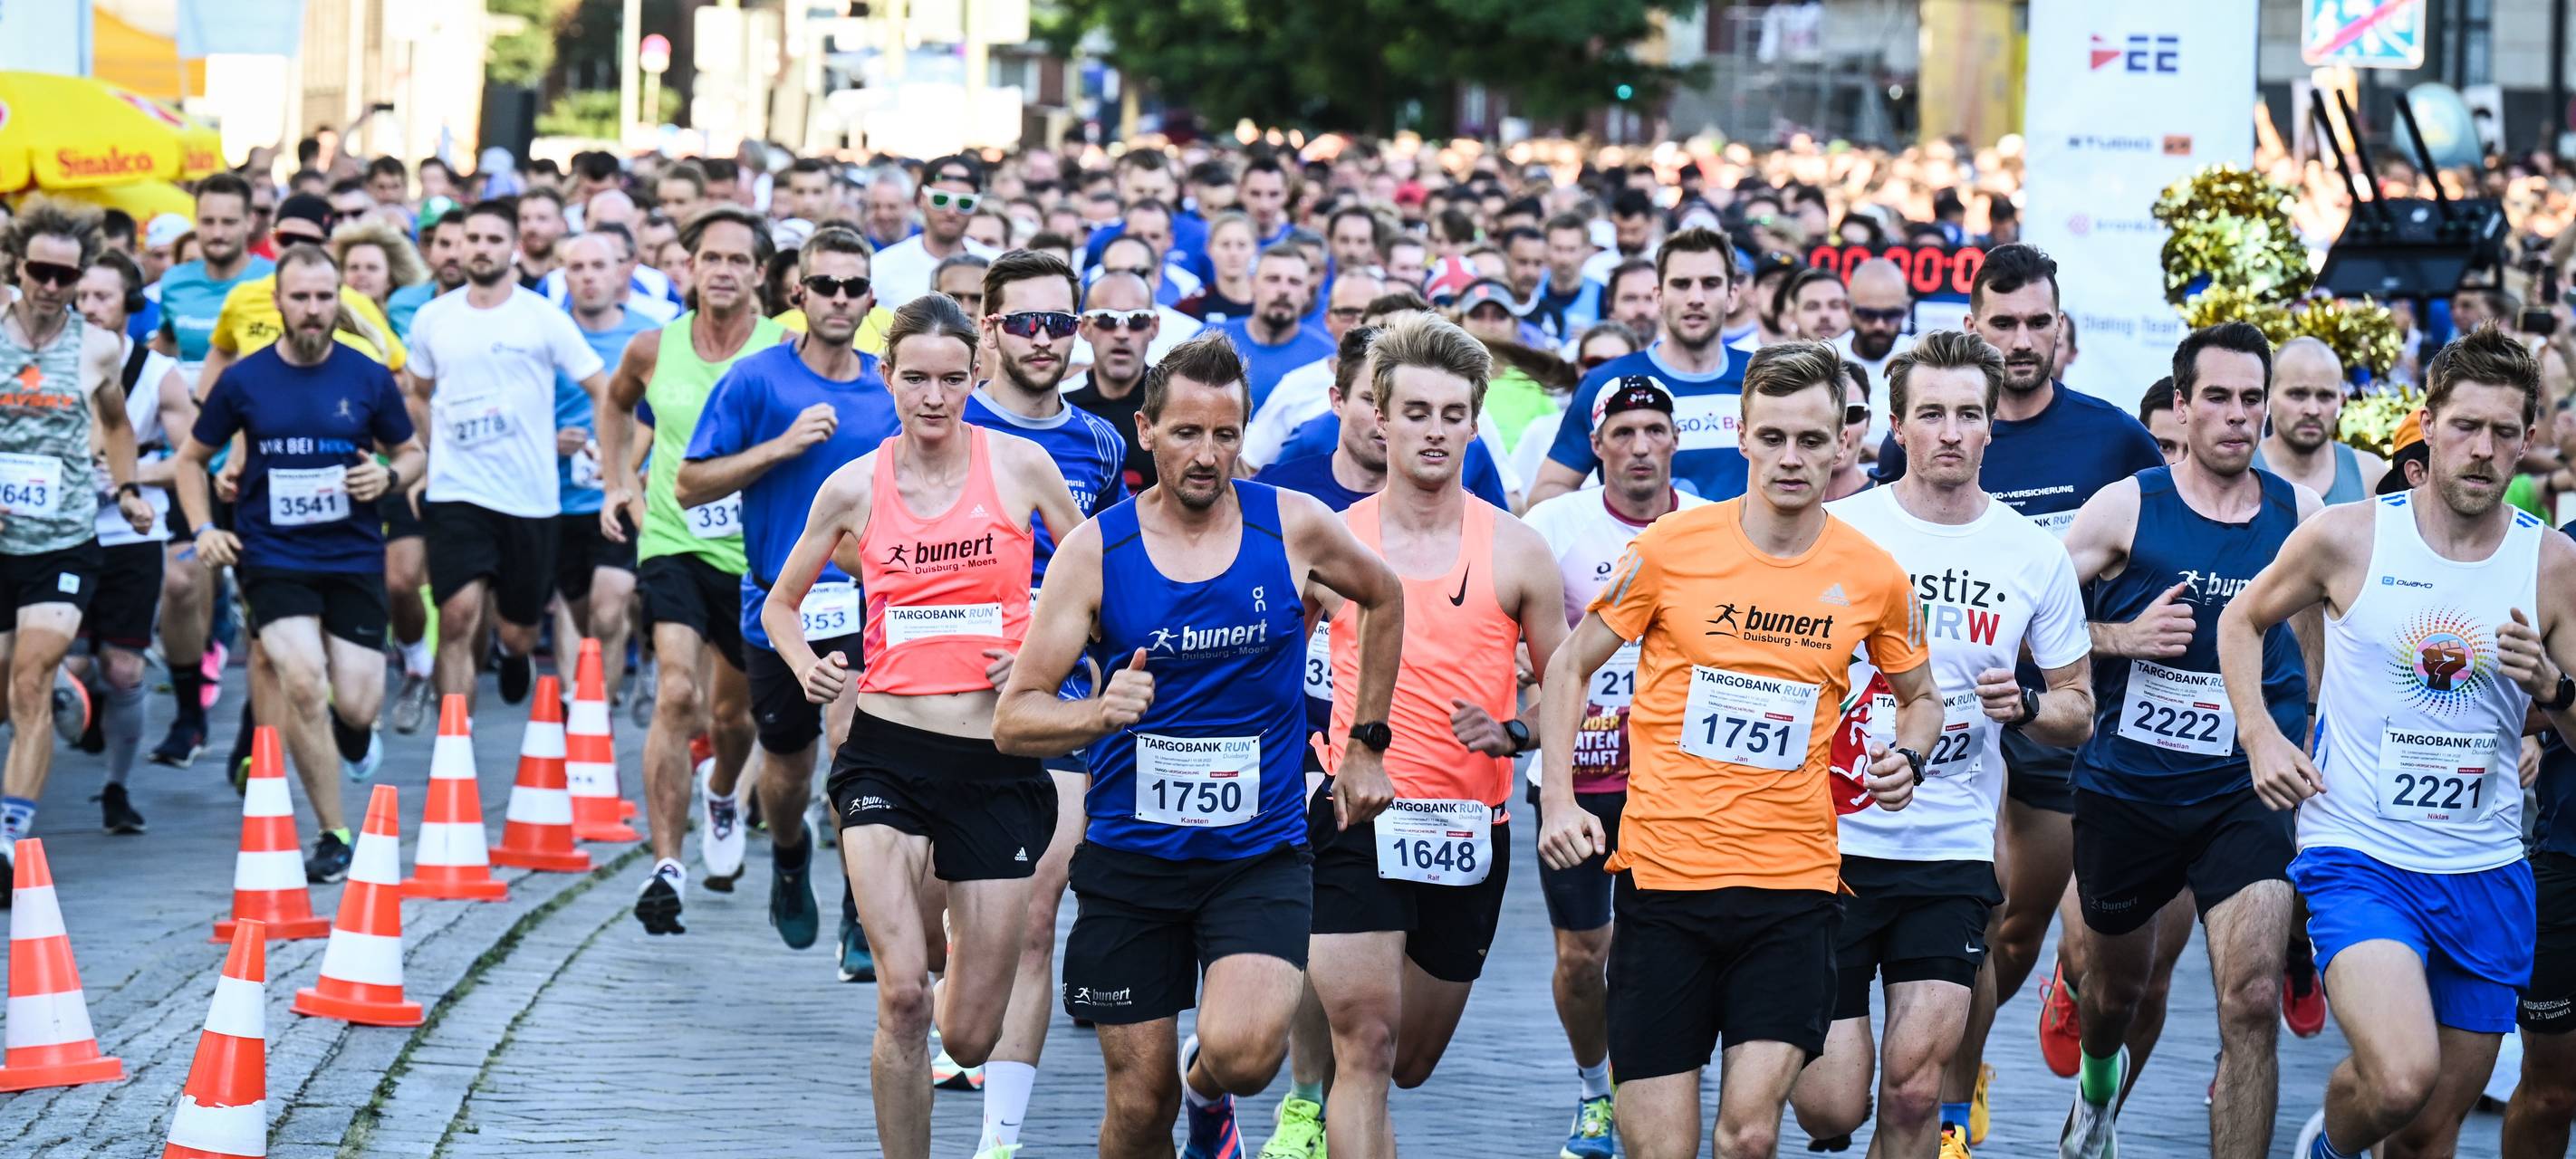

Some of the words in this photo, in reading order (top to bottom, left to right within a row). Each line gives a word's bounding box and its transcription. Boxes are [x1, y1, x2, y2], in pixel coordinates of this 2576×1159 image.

[56, 148, 153, 178] Sinalco
[0, 484, 45, 506] 643
[281, 495, 336, 516] 3541
[914, 532, 994, 565] bunert
[915, 561, 959, 575] Duisburg
[967, 557, 997, 569] Moers
[892, 608, 966, 620] TARGOBANK
[968, 608, 994, 618] RUN
[1745, 605, 1833, 638] bunert
[1181, 618, 1268, 652] bunert
[1744, 632, 1792, 647] Duisburg
[1801, 637, 1831, 650] Moers
[1182, 648, 1230, 661] Duisburg
[1238, 645, 1270, 655] Moers
[1699, 670, 1782, 694] TARGOBANK
[1783, 685, 1811, 698] RUN
[2138, 661, 2209, 686] TARGOBANK
[2210, 676, 2225, 687] RU
[2134, 700, 2221, 743] 2222
[1144, 737, 1222, 752] TARGOBANK
[1224, 742, 1250, 752] RUN
[1702, 713, 1791, 757] 1751
[2157, 738, 2189, 750] Sebastian
[2390, 732, 2471, 749] TARGOBANK
[2474, 738, 2498, 749] RUN
[1735, 754, 1748, 762] Jan
[1152, 779, 1242, 814] 1750
[2392, 773, 2483, 809] 2221
[1387, 801, 1457, 813] ARGOBANK
[1459, 803, 1483, 814] RUN
[2427, 812, 2449, 820] Niklas
[1180, 816, 1209, 825] Karsten
[1393, 838, 1476, 873] 1648
[1092, 987, 1130, 1001] bunert
